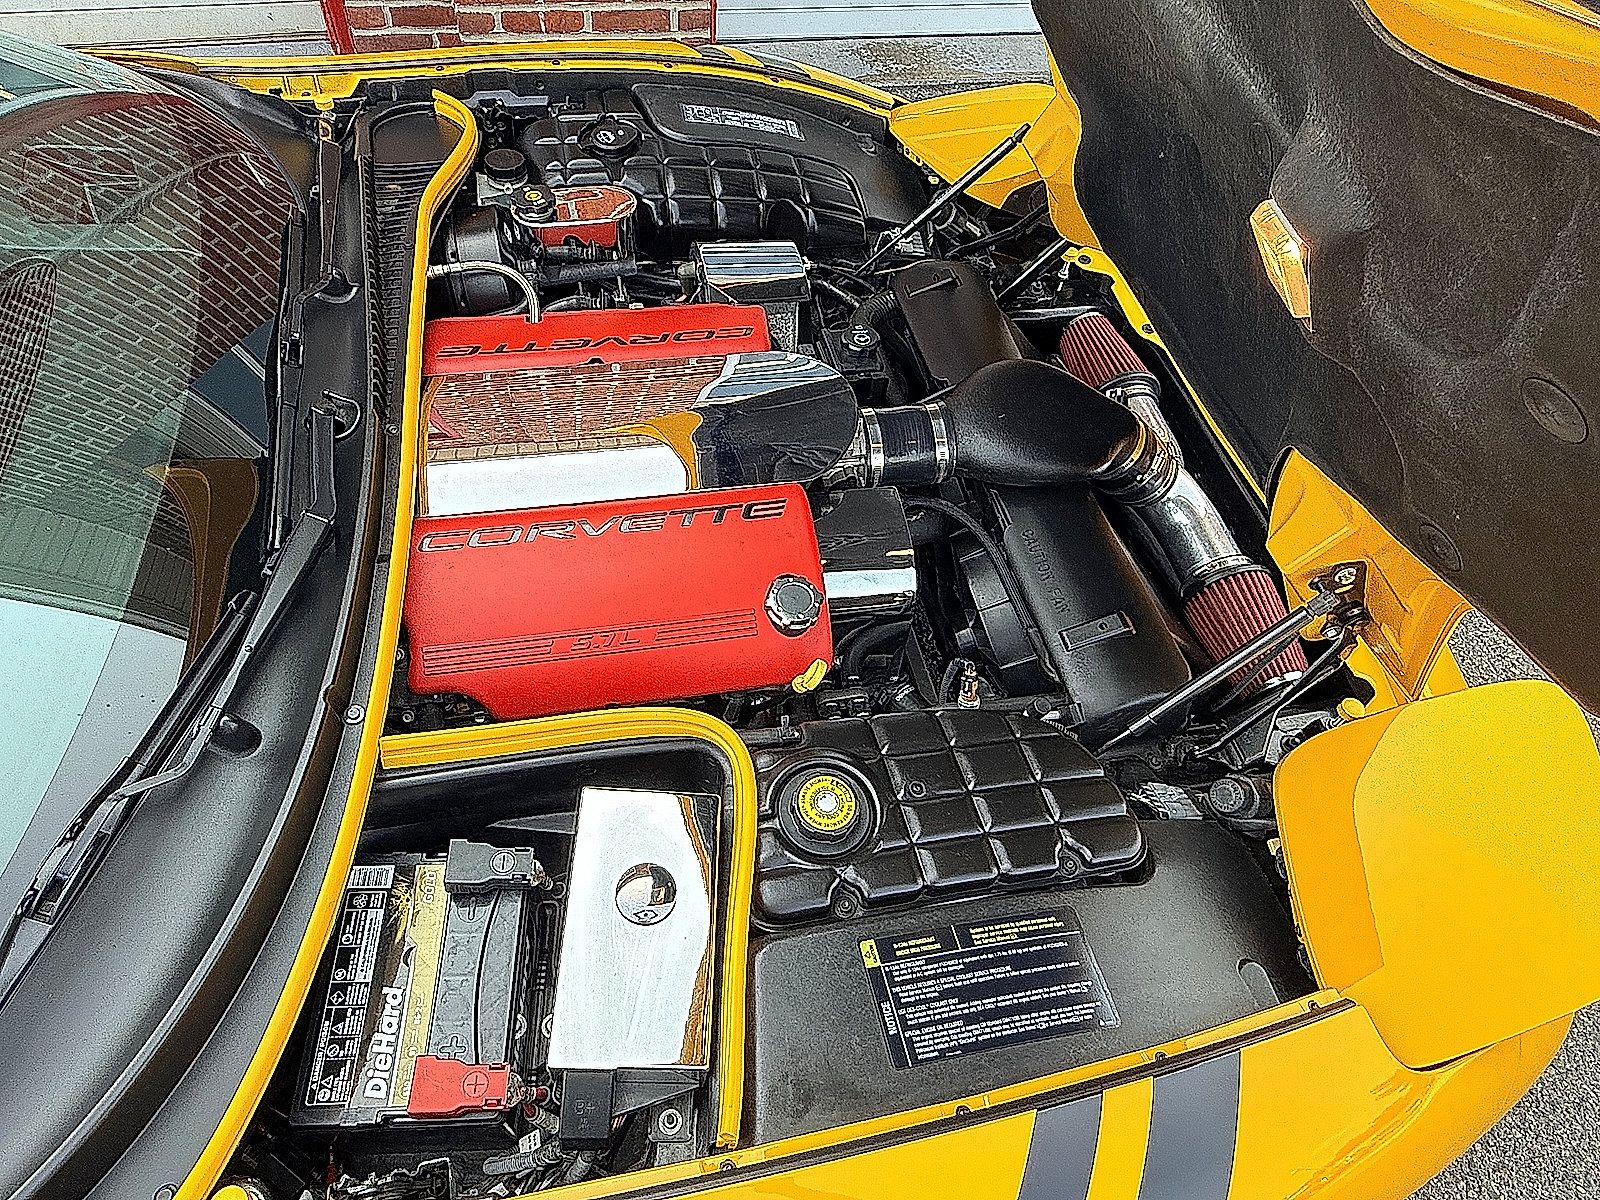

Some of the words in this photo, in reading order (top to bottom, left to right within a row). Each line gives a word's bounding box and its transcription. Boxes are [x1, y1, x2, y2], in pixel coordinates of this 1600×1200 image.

[435, 325, 755, 359] CORVETTE
[417, 498, 788, 553] CORVETTE
[571, 631, 640, 651] 5.7L
[880, 1001, 898, 1035] NOTICE
[364, 986, 405, 1101] DieHard
